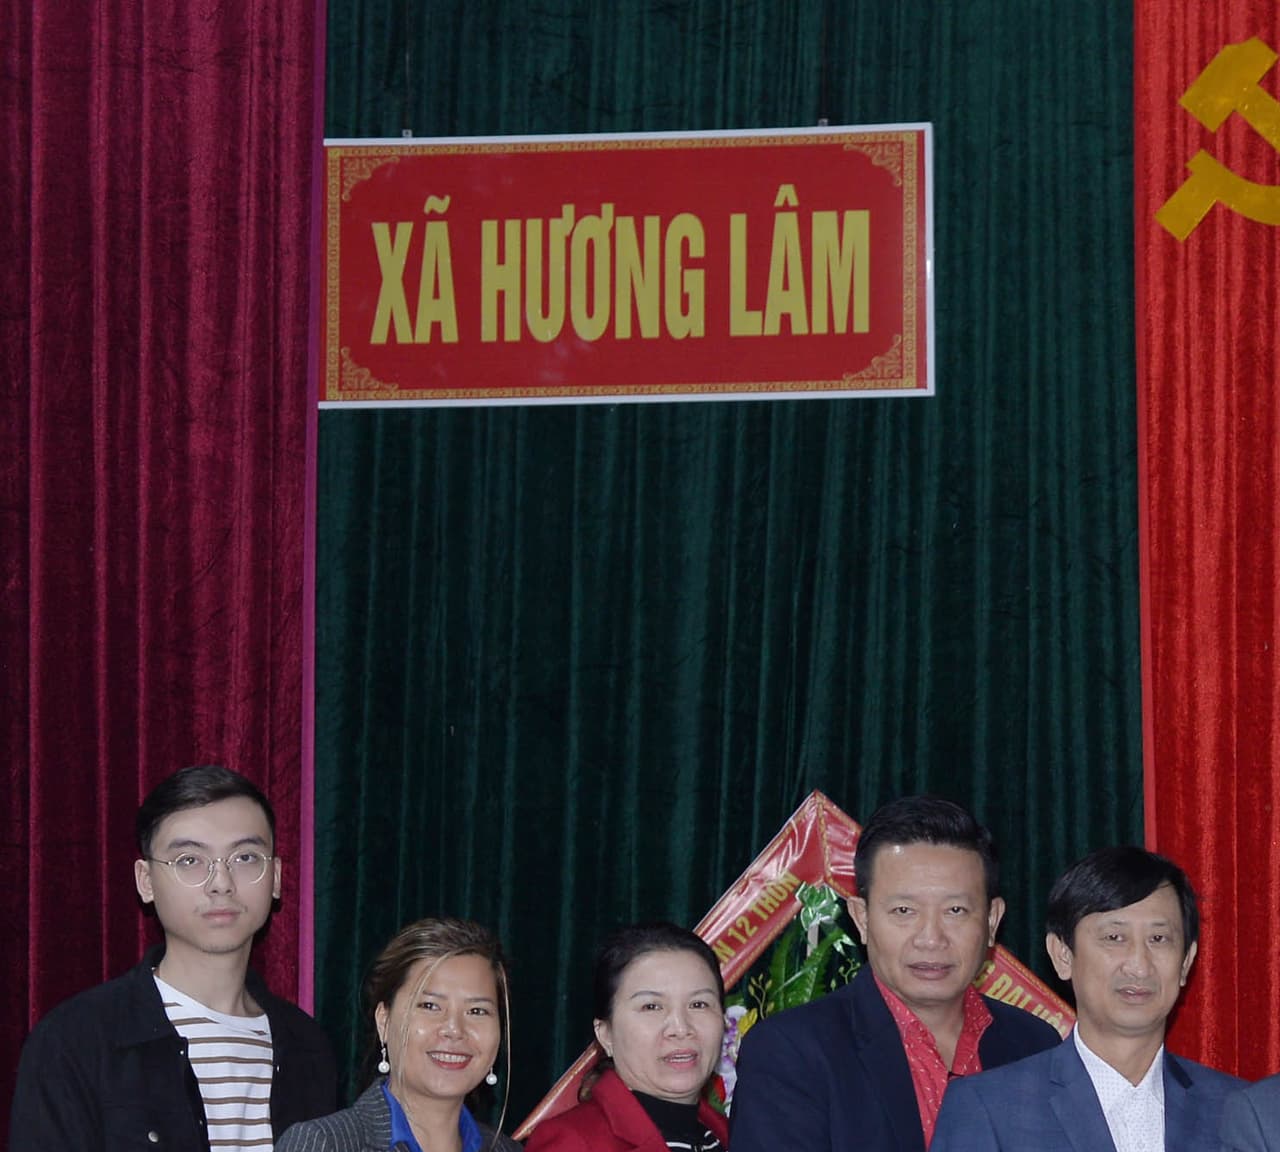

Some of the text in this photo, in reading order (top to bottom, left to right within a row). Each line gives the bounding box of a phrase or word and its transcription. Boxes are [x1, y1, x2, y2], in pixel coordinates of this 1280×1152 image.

[370, 184, 870, 344] XÃ HƯƠNG LÂM
[728, 916, 758, 945] 12
